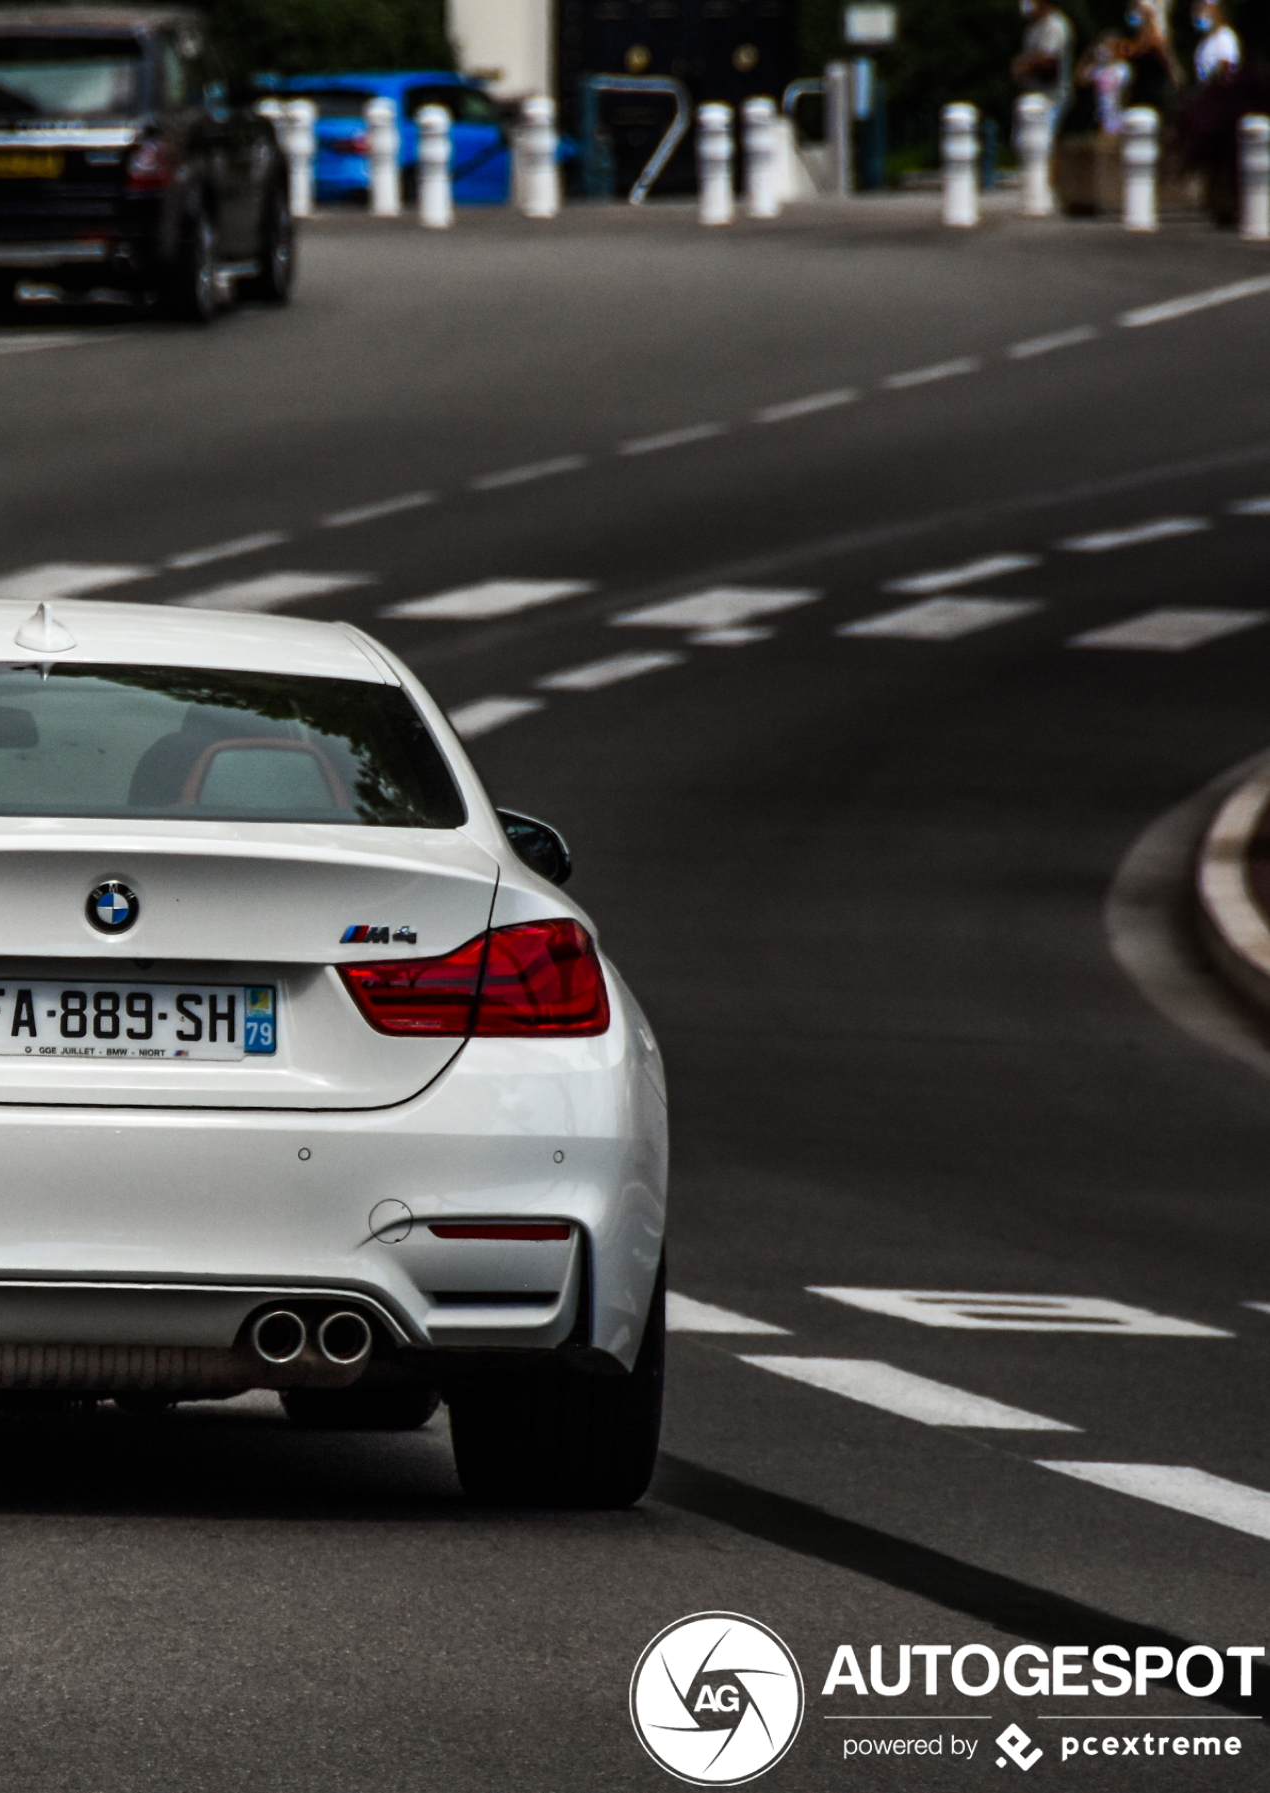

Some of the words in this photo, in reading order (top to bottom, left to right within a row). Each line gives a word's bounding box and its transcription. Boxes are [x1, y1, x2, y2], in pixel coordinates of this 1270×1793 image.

[91, 882, 135, 900] BMW
[246, 1021, 273, 1046] 79
[60, 1047, 95, 1056] JUILLET
[106, 1048, 128, 1057] BMW
[138, 1048, 166, 1057] NIORT
